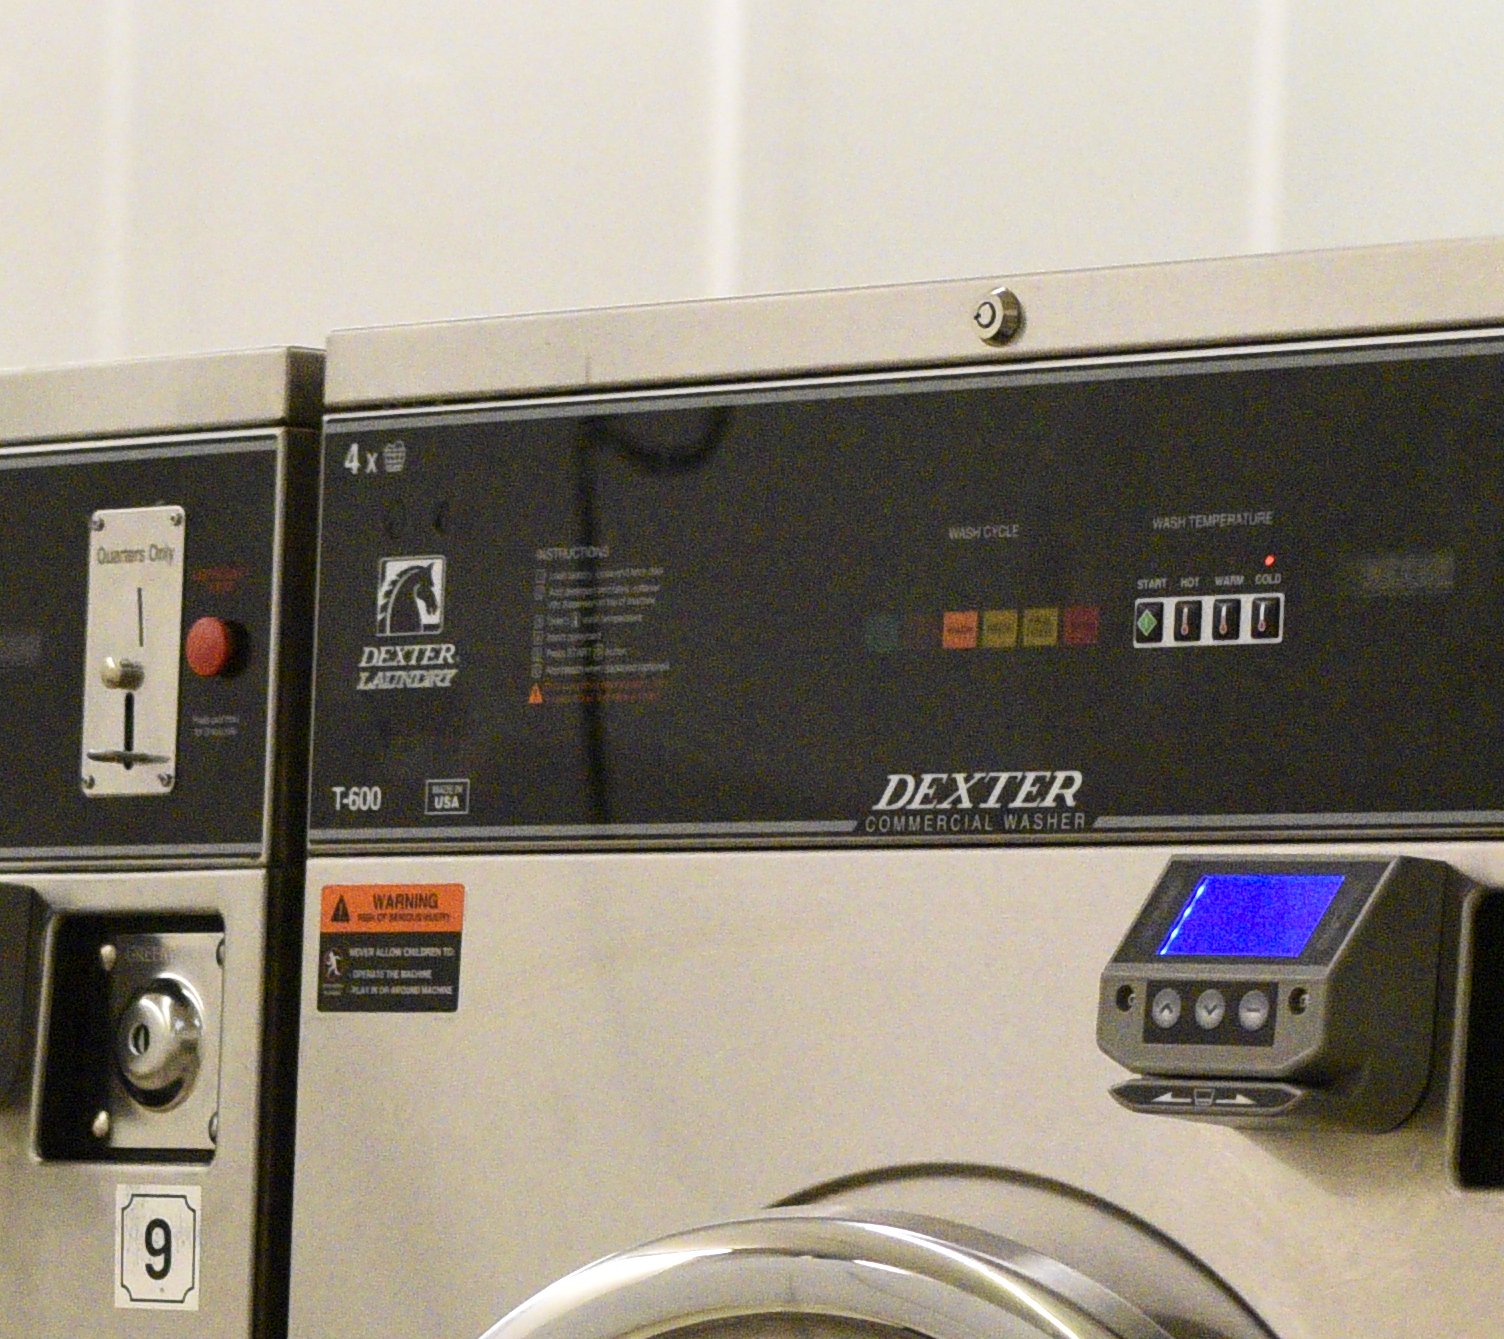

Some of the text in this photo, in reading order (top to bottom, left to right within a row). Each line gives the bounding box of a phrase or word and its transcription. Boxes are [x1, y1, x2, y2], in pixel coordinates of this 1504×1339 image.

[344, 442, 378, 475] 4 x
[1152, 511, 1274, 529] WASH TEMPERATURE
[948, 523, 1019, 540] WASH CYCLE
[97, 543, 175, 567] Quarters Only
[1136, 578, 1167, 590] START
[1180, 576, 1200, 588] HOT
[1214, 575, 1245, 587] WARM
[1254, 573, 1282, 585] COLD
[357, 643, 456, 668] DEXTER
[356, 668, 459, 690] LAUNDRY
[332, 786, 382, 811] T-600
[871, 770, 1083, 811] DEXTER
[434, 795, 460, 809] USA
[865, 812, 1085, 832] COMMERCIAL WASHER
[372, 892, 439, 910] WARNING
[375, 946, 402, 957] ALLOW
[403, 946, 441, 957] CHILDREN
[145, 1217, 173, 1281] 9
